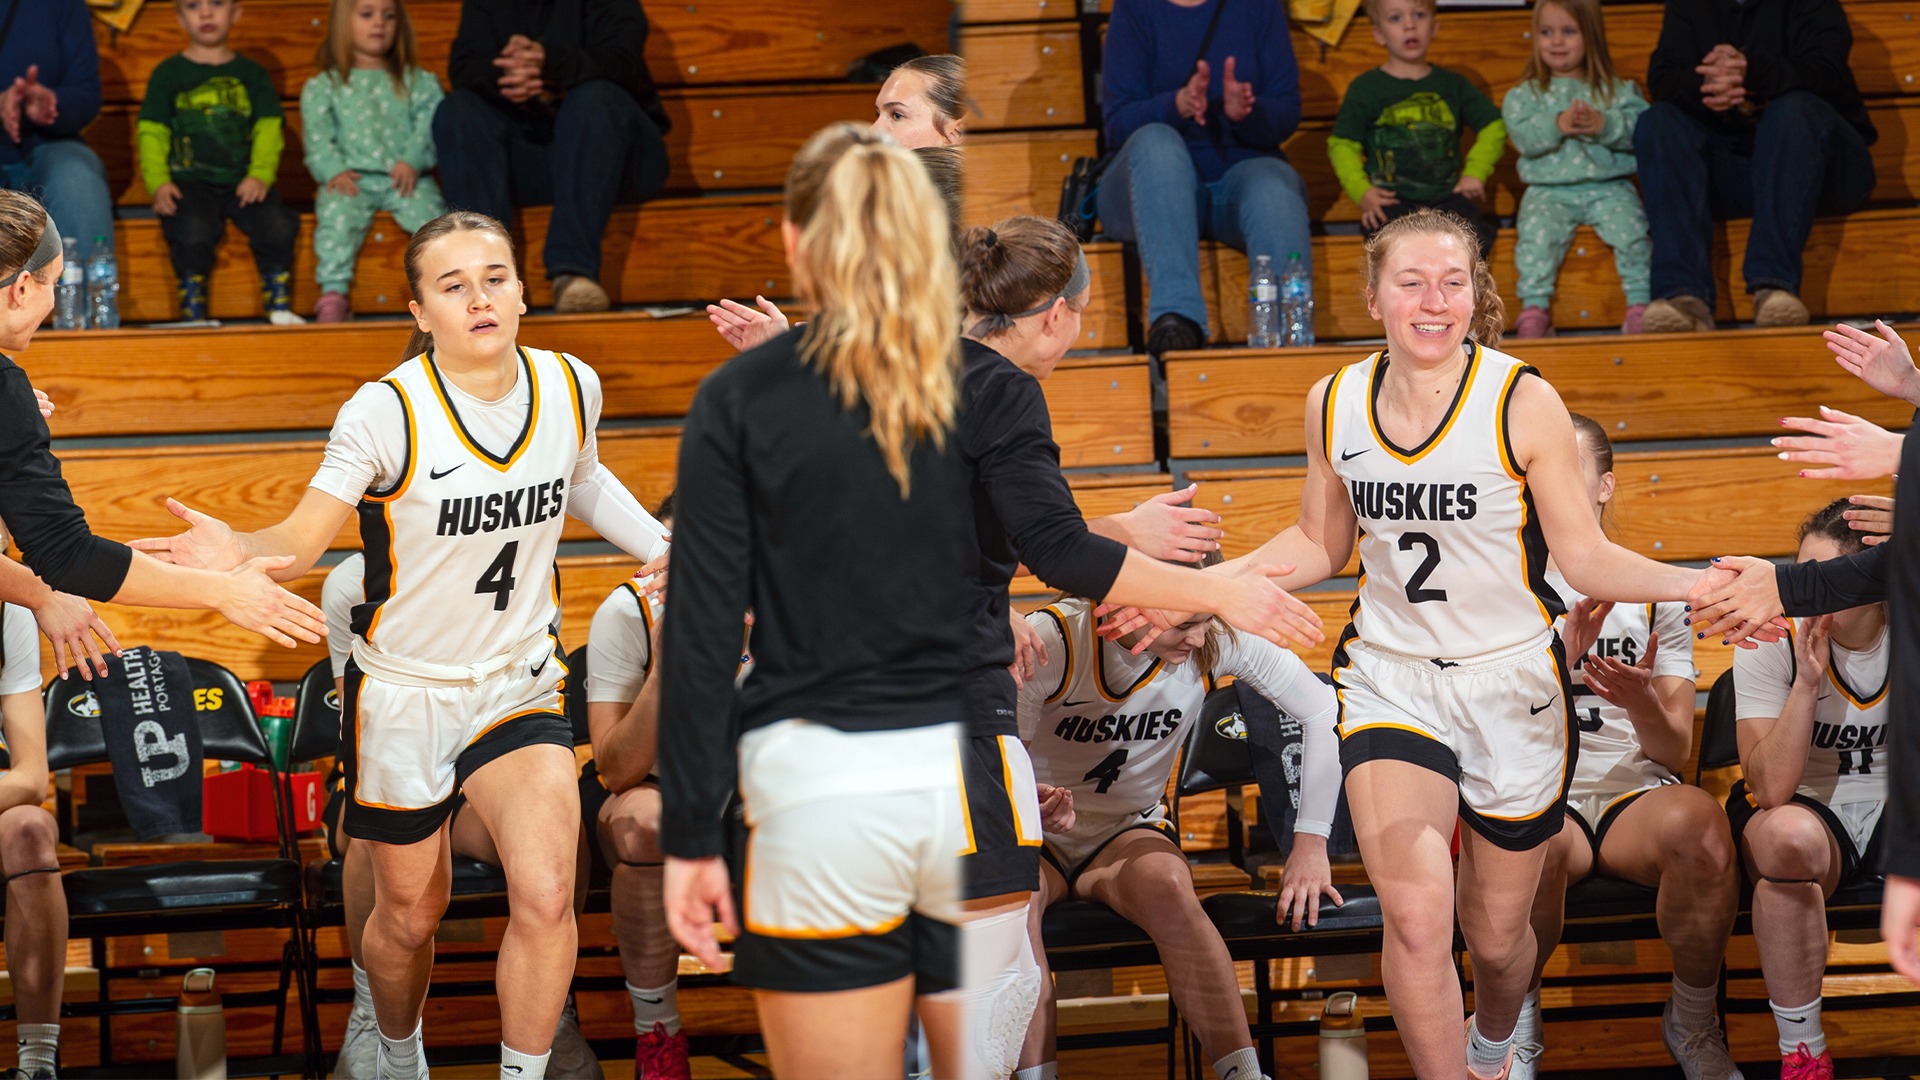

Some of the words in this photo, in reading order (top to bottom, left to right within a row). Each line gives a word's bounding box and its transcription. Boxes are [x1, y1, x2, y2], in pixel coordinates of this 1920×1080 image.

[436, 477, 565, 536] HUSKIES
[1351, 480, 1478, 521] HUSKIES
[474, 540, 519, 611] 4
[1397, 531, 1448, 604] 2
[123, 649, 155, 715] HEALTH
[133, 720, 191, 788] UP
[1054, 708, 1183, 743] HUSKIES
[1811, 720, 1889, 750] USKI
[1082, 749, 1129, 794] 4
